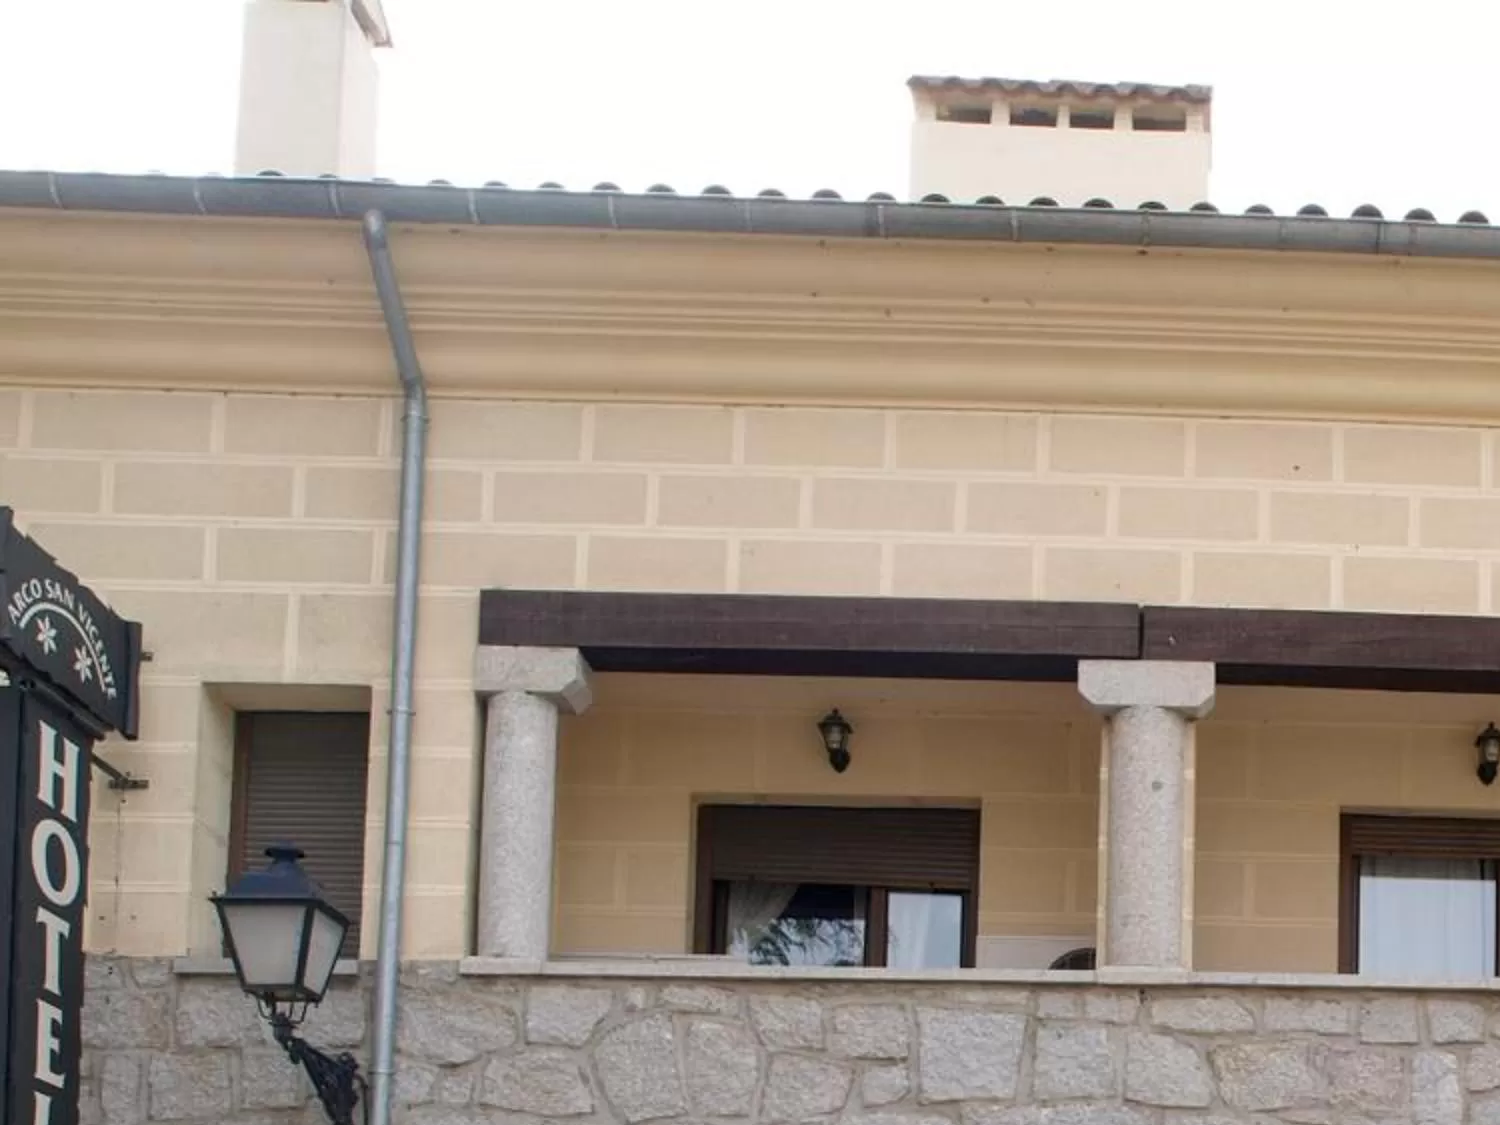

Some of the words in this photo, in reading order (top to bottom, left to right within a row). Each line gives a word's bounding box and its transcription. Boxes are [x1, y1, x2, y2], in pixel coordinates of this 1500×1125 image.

[7, 578, 43, 624] ARCO
[44, 579, 75, 611] SAN
[79, 603, 117, 699] VICENTE
